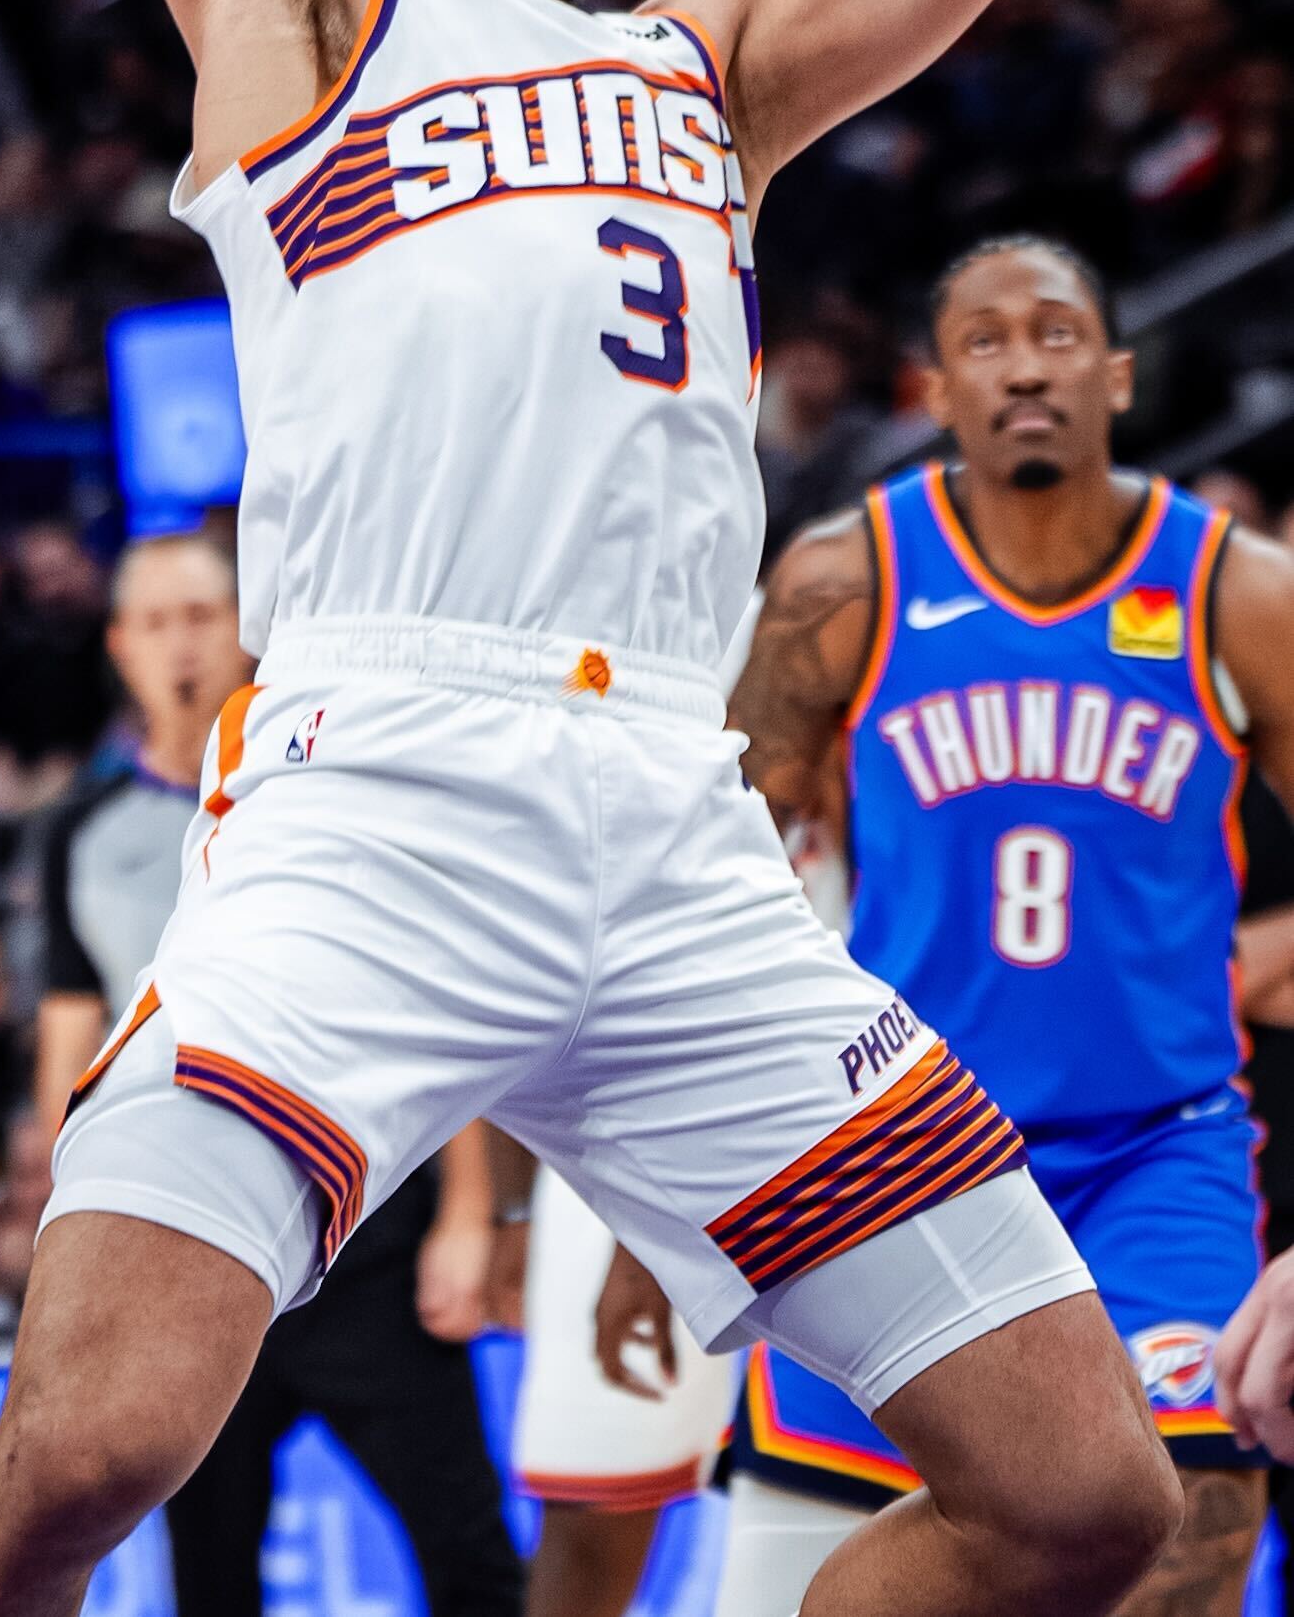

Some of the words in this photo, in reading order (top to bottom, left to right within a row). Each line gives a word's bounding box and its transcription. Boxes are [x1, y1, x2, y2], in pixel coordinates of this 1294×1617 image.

[385, 70, 733, 222] SUNS
[597, 215, 689, 395] 3
[878, 681, 1202, 824] THUNDER
[992, 824, 1075, 970] 8
